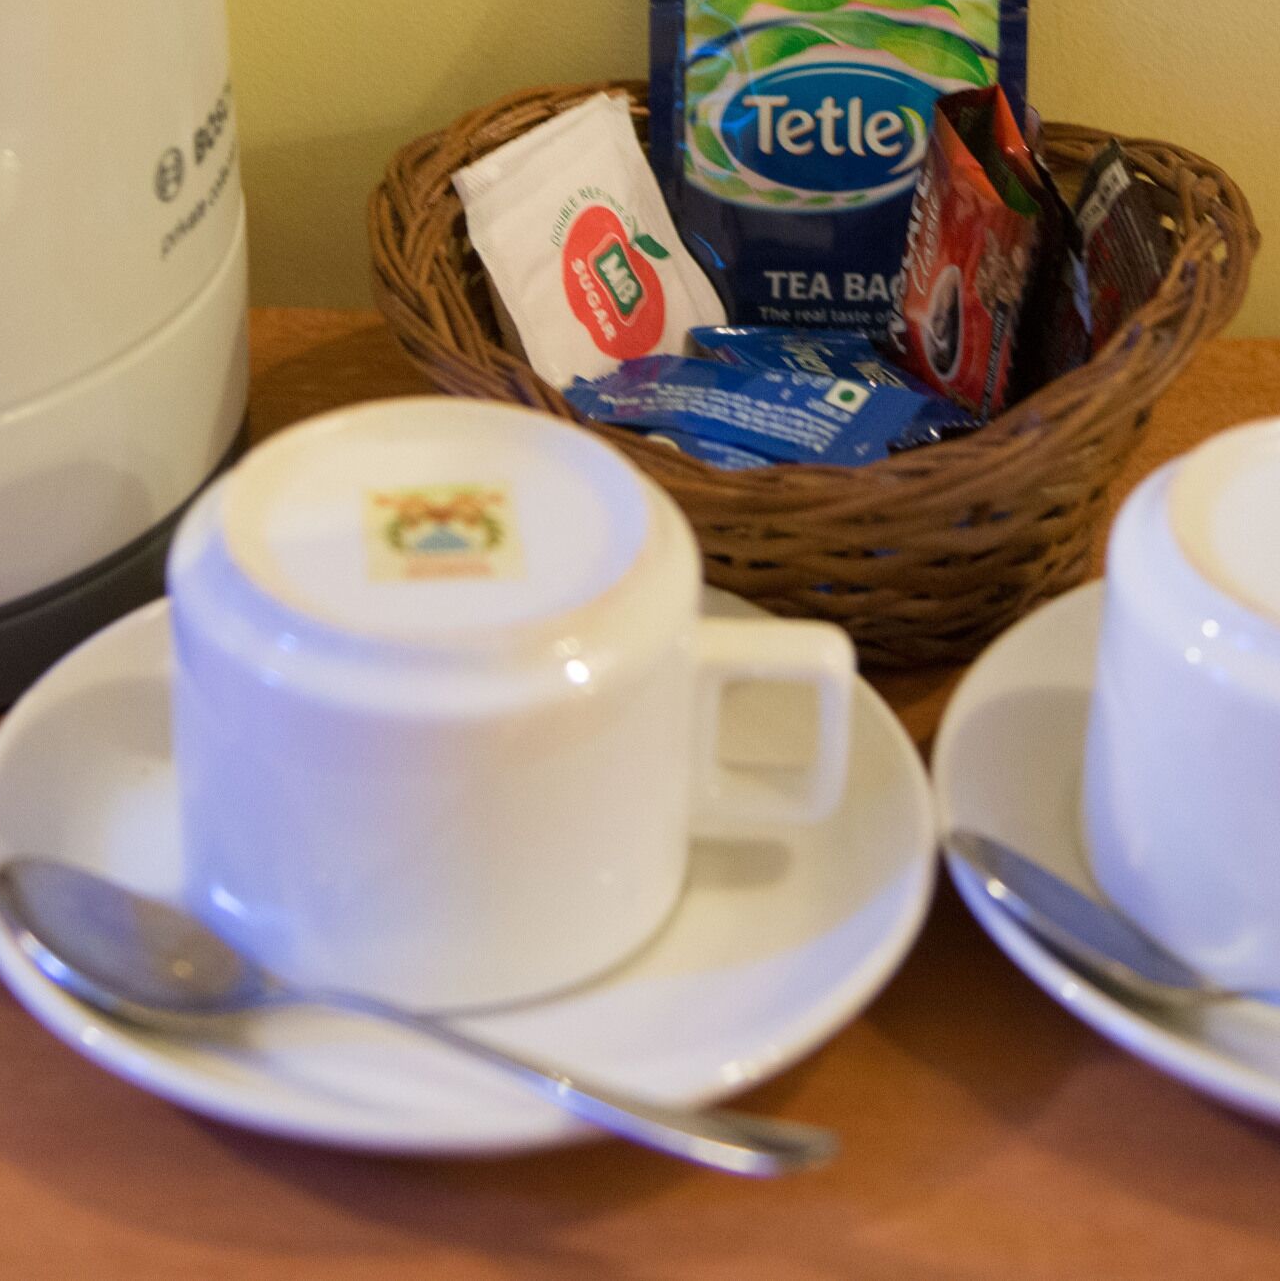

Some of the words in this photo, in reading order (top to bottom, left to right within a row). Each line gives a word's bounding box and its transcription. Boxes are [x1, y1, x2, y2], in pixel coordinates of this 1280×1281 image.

[571, 258, 617, 342] SUGAR
[763, 270, 832, 300] TEA
[758, 305, 791, 323] The
[794, 307, 826, 324] real
[830, 308, 871, 325] taste
